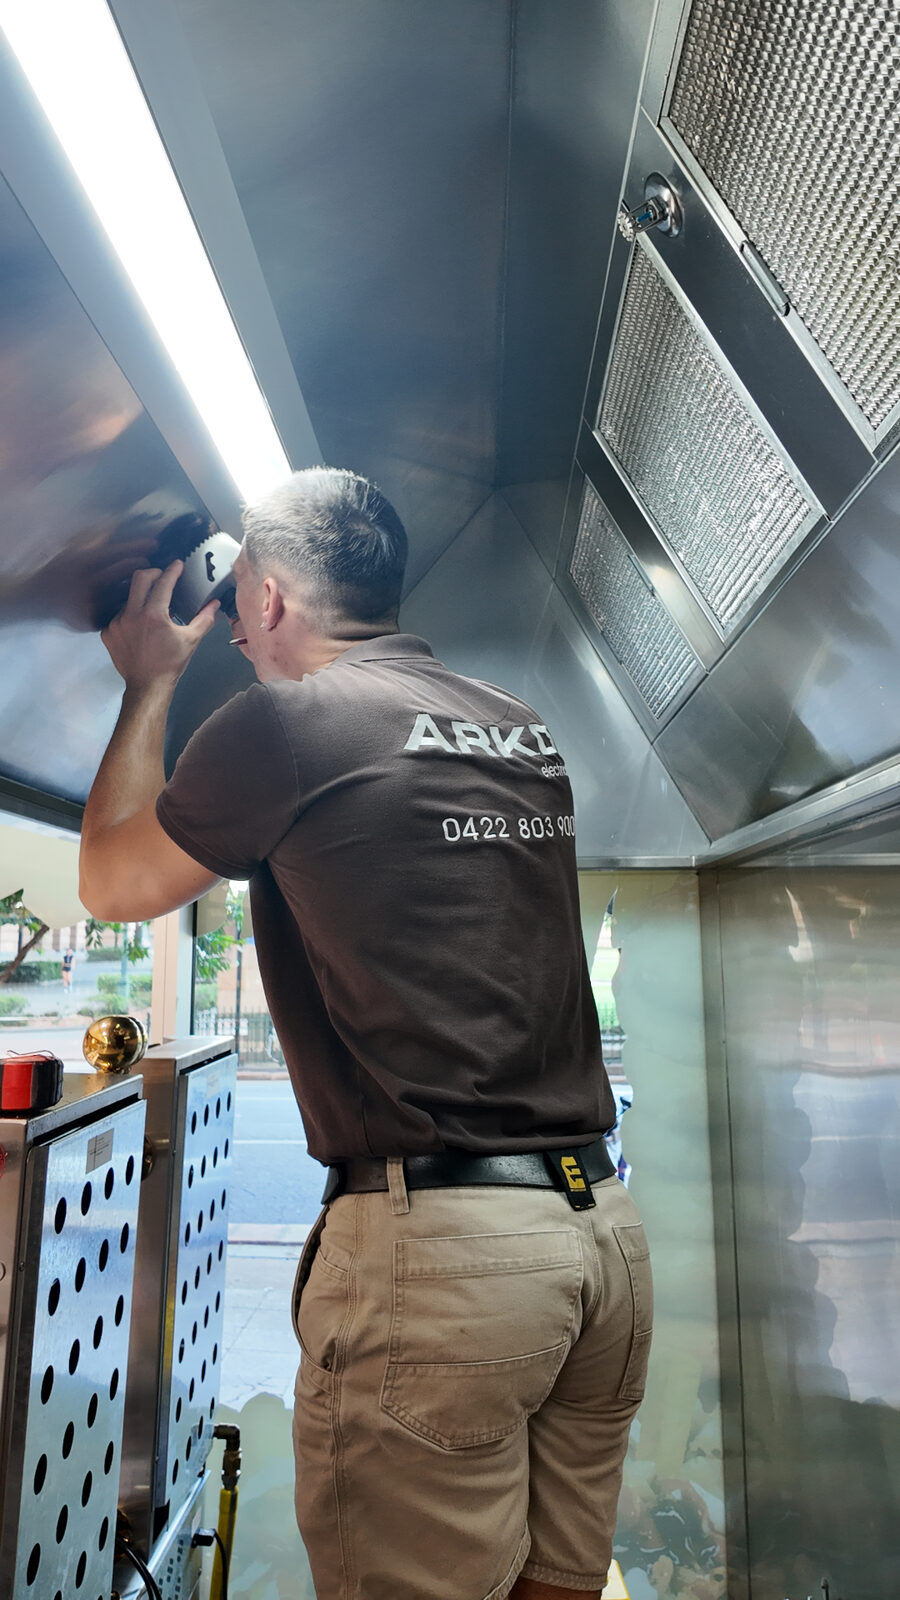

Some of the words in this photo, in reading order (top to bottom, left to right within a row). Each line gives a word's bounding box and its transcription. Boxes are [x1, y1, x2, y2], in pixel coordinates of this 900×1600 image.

[442, 816, 510, 842] 0422
[518, 816, 554, 839] 803
[557, 815, 576, 837] 900
